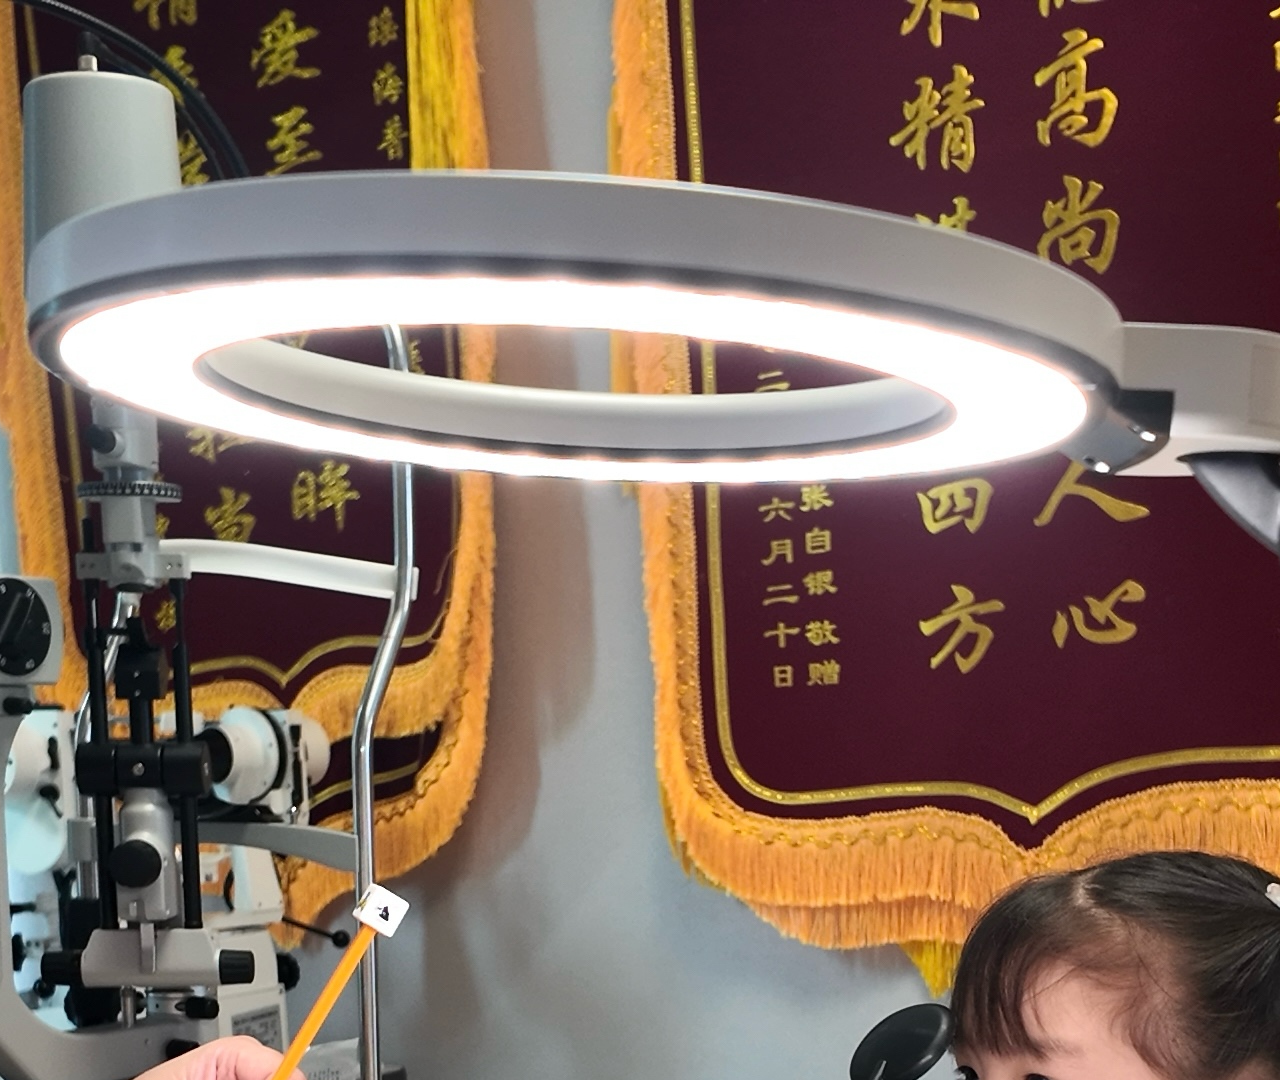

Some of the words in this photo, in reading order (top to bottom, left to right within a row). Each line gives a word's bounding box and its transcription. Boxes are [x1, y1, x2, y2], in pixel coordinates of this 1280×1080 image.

[1034, 0, 1121, 275] 高尚
[757, 497, 801, 689] 六月二十日
[919, 476, 1006, 676] 四方
[1033, 464, 1150, 652] 人心
